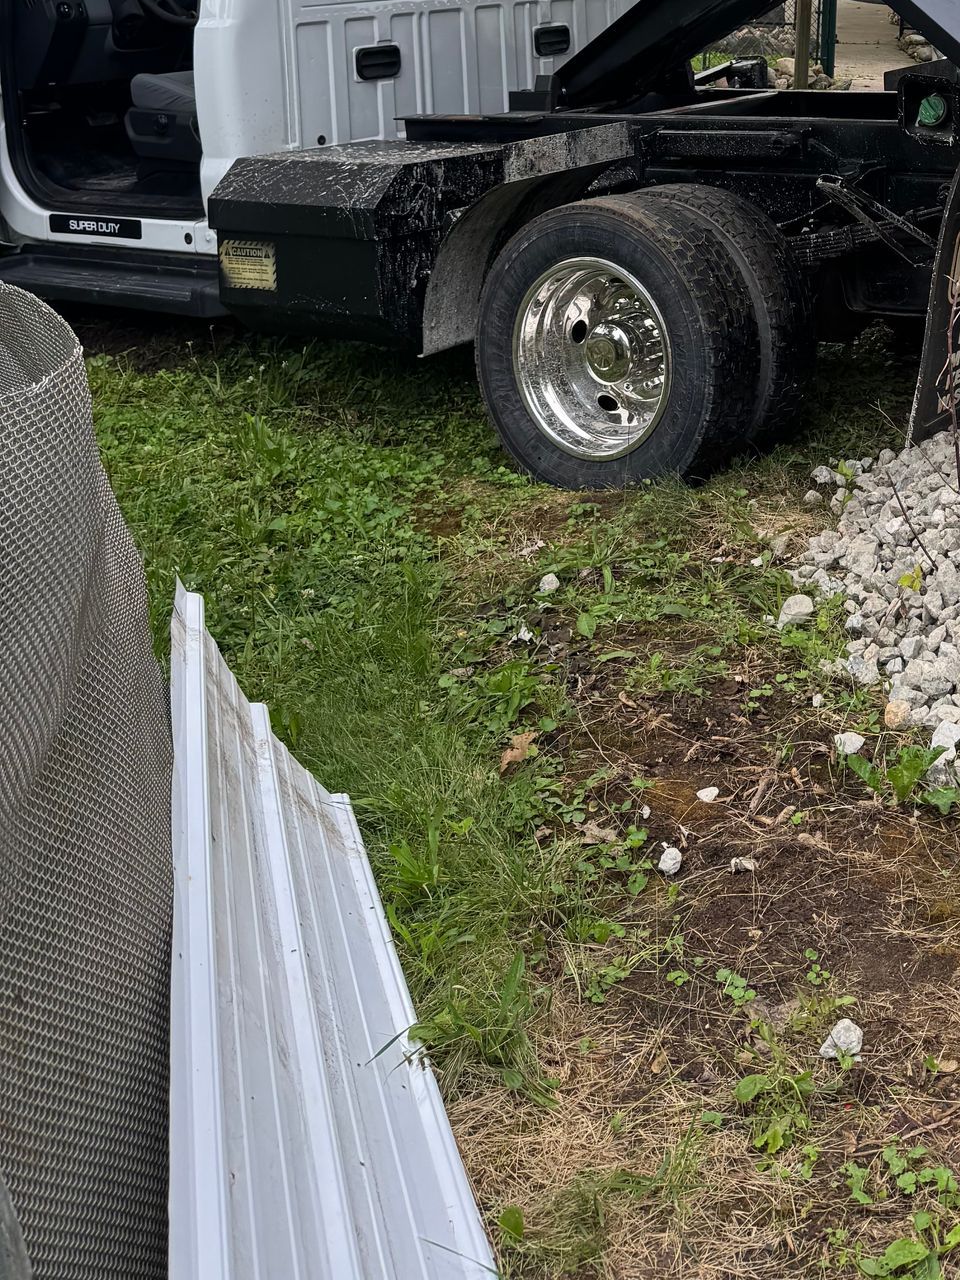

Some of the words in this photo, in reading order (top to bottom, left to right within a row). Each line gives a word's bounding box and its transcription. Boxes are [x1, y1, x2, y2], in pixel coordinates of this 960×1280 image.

[69, 219, 97, 231] SUPER
[98, 221, 120, 233] DUTY
[232, 247, 263, 257] CAUTION
